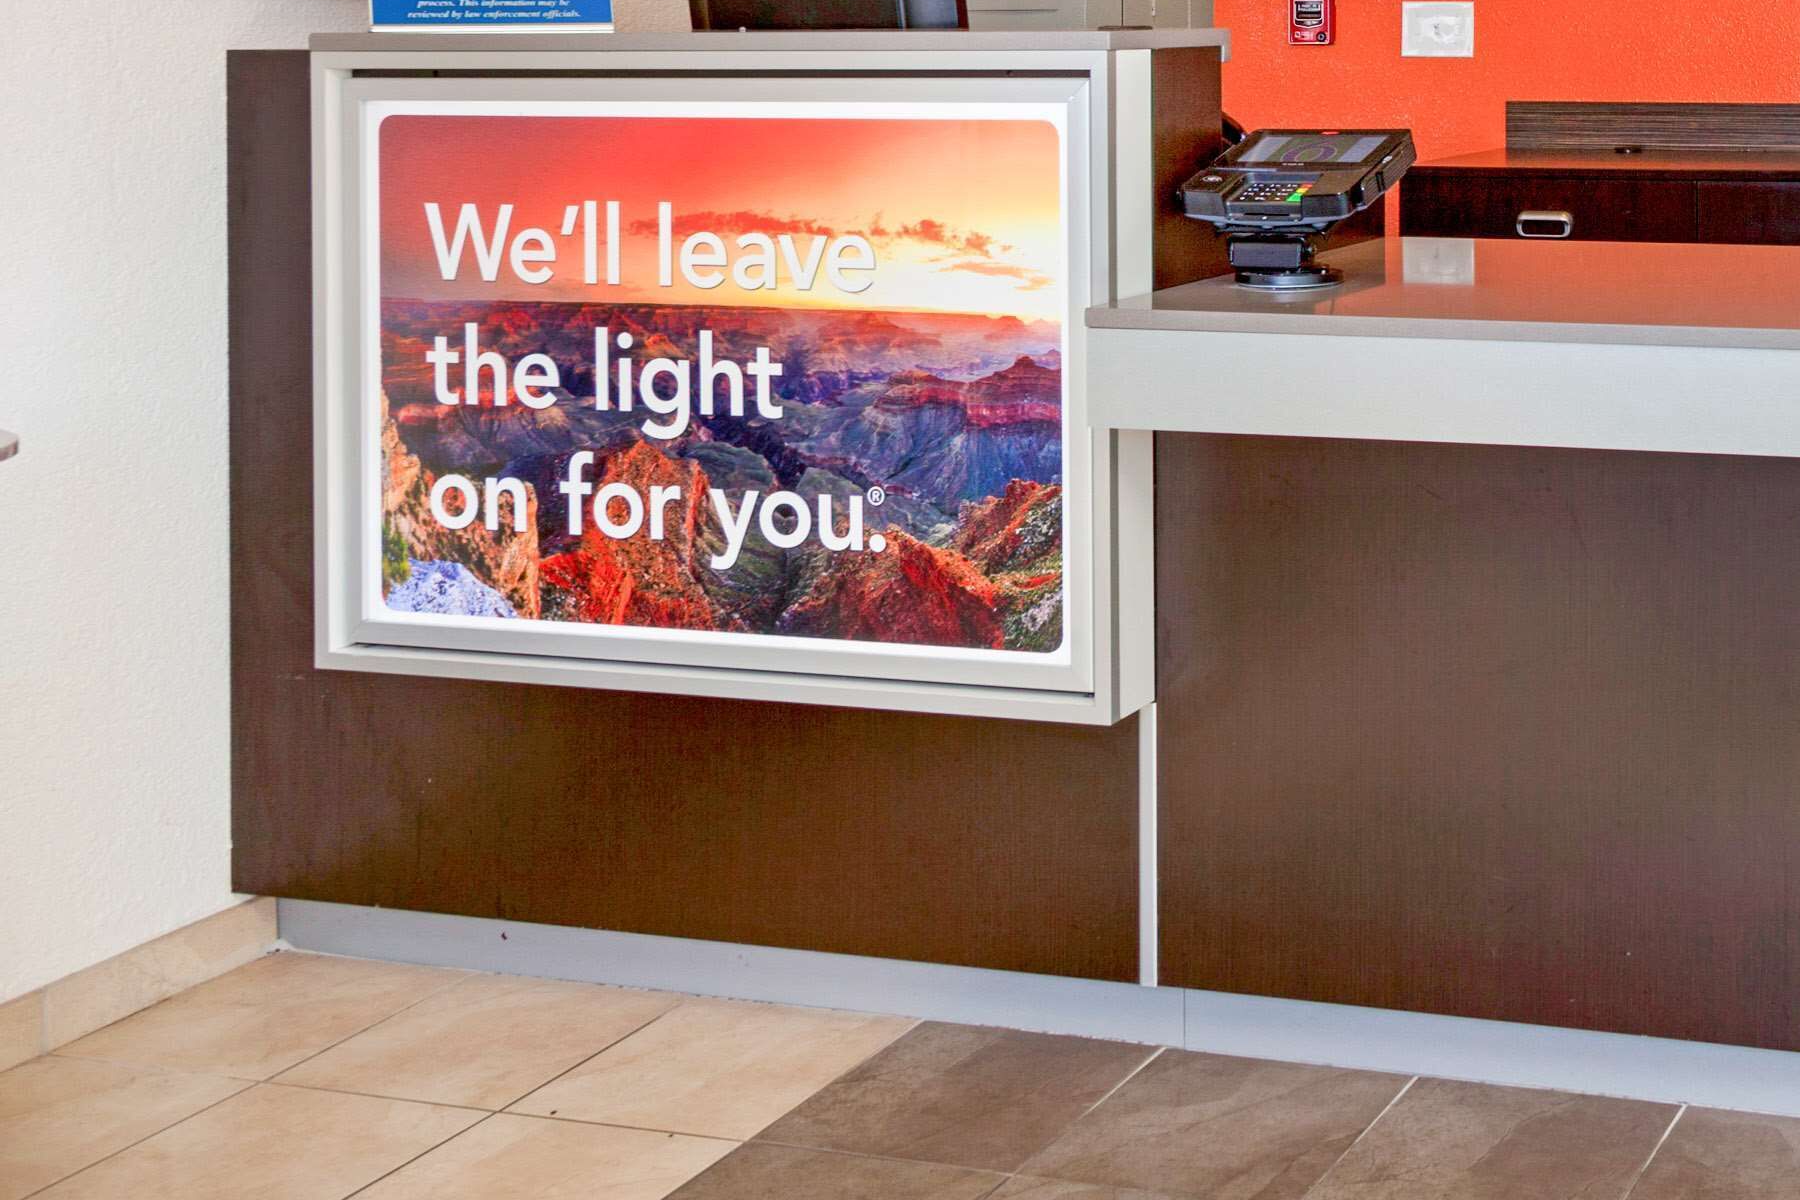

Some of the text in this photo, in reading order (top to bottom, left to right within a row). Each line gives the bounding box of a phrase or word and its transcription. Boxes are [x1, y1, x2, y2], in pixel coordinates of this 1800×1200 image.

[407, 10, 581, 20] reviewed by law enforcement officials.
[417, 0, 456, 9] process.
[481, 0, 536, 8] information
[537, 0, 557, 8] may
[424, 200, 877, 294] We'll leave
[425, 323, 784, 440] the light
[430, 472, 528, 533] on
[559, 451, 681, 541] for
